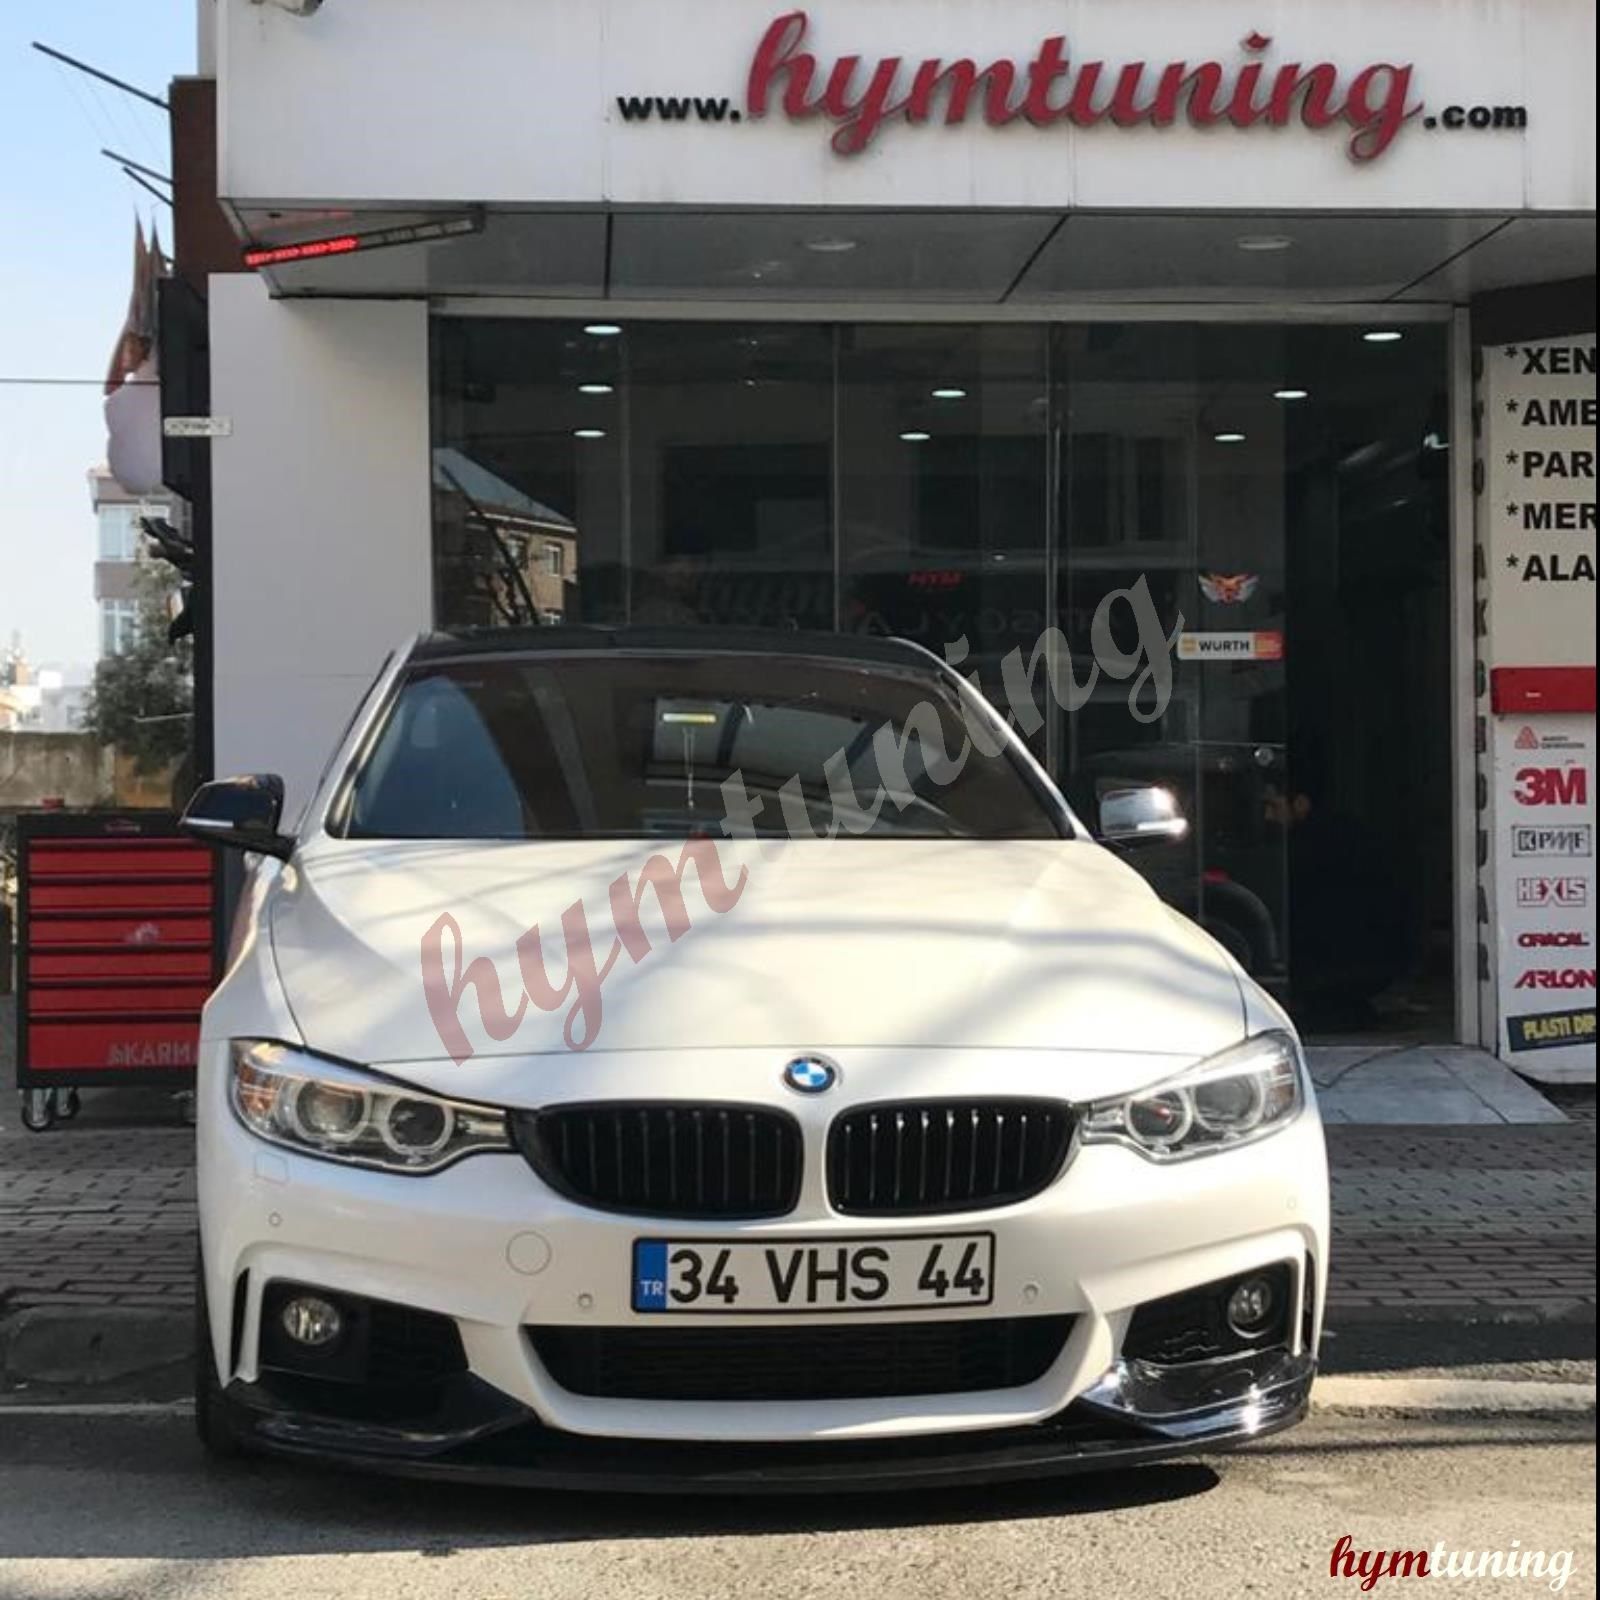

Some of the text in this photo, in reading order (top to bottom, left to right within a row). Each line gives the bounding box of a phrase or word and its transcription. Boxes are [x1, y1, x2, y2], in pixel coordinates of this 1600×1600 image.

[617, 11, 1528, 161] www.hymtuning.com
[1523, 451, 1596, 478] PAR
[1522, 555, 1596, 582] ALA
[1514, 767, 1587, 806] 3M
[1517, 878, 1587, 903] HEXIS
[1514, 969, 1596, 989] ARLON
[640, 1242, 985, 1304] TR 34 VHS 44
